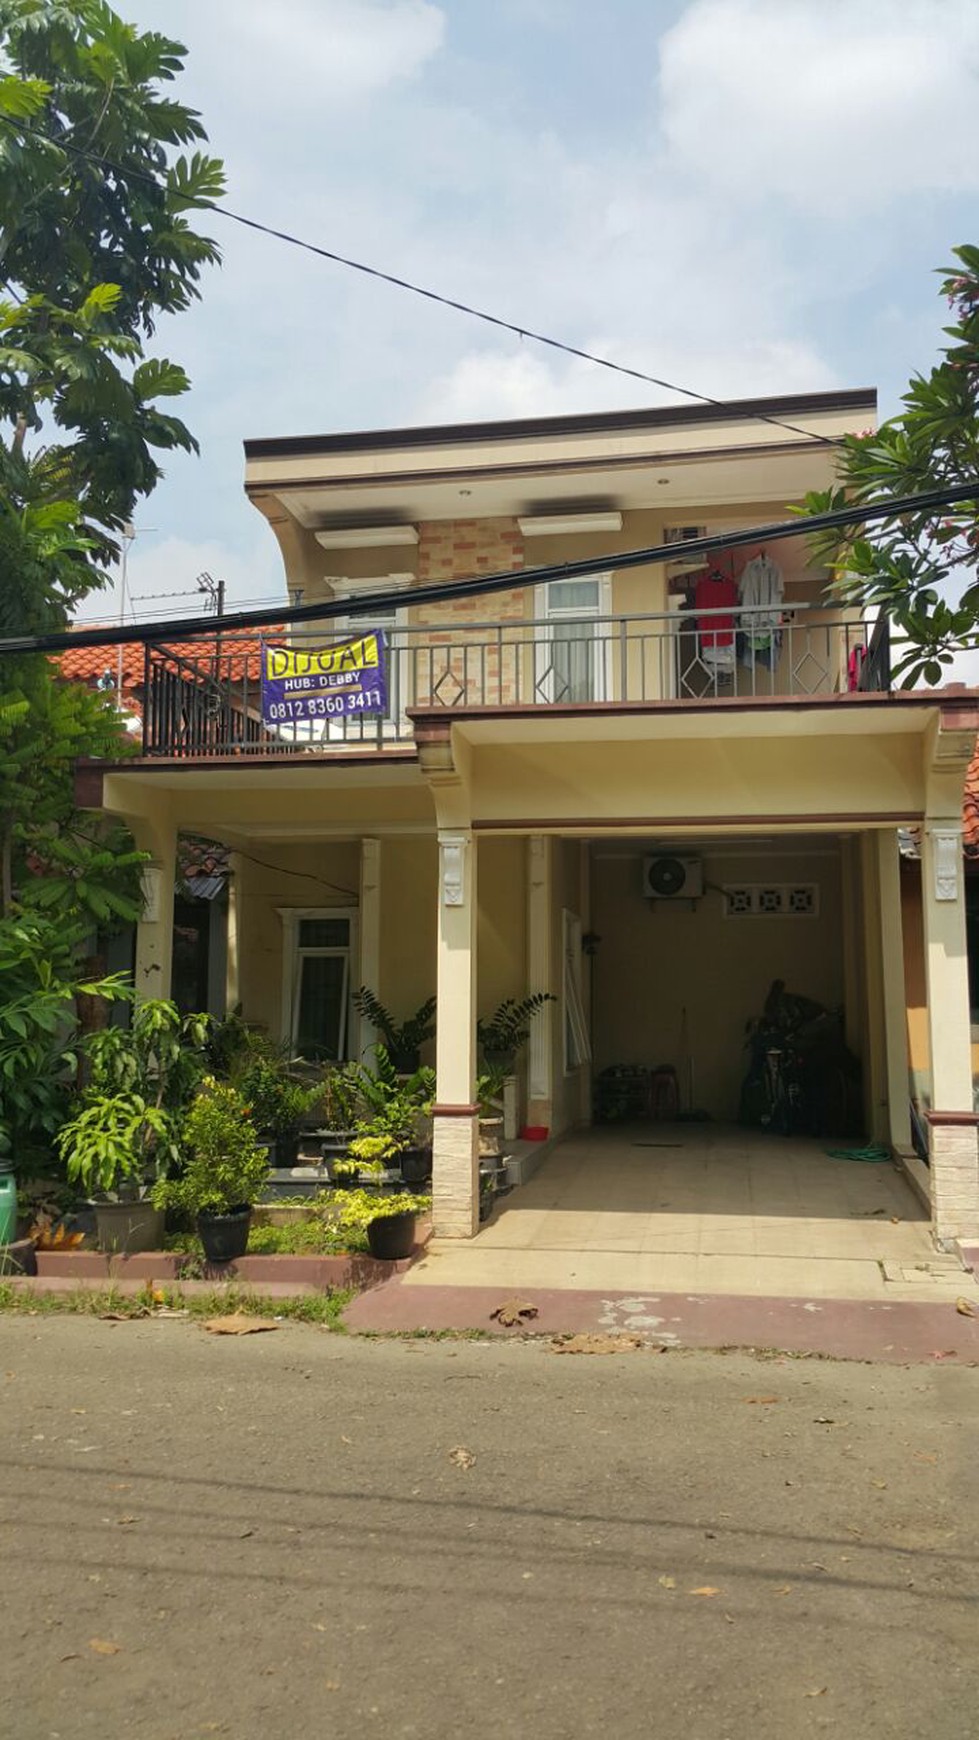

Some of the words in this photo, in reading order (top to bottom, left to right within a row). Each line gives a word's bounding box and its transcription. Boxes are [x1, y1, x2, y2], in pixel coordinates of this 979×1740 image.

[272, 641, 375, 677] DIJUAL
[285, 678, 315, 690] HUB:
[319, 672, 360, 686] DEBBY
[270, 701, 305, 719] 0812
[308, 696, 344, 715] 8360
[348, 690, 381, 709] 3411
